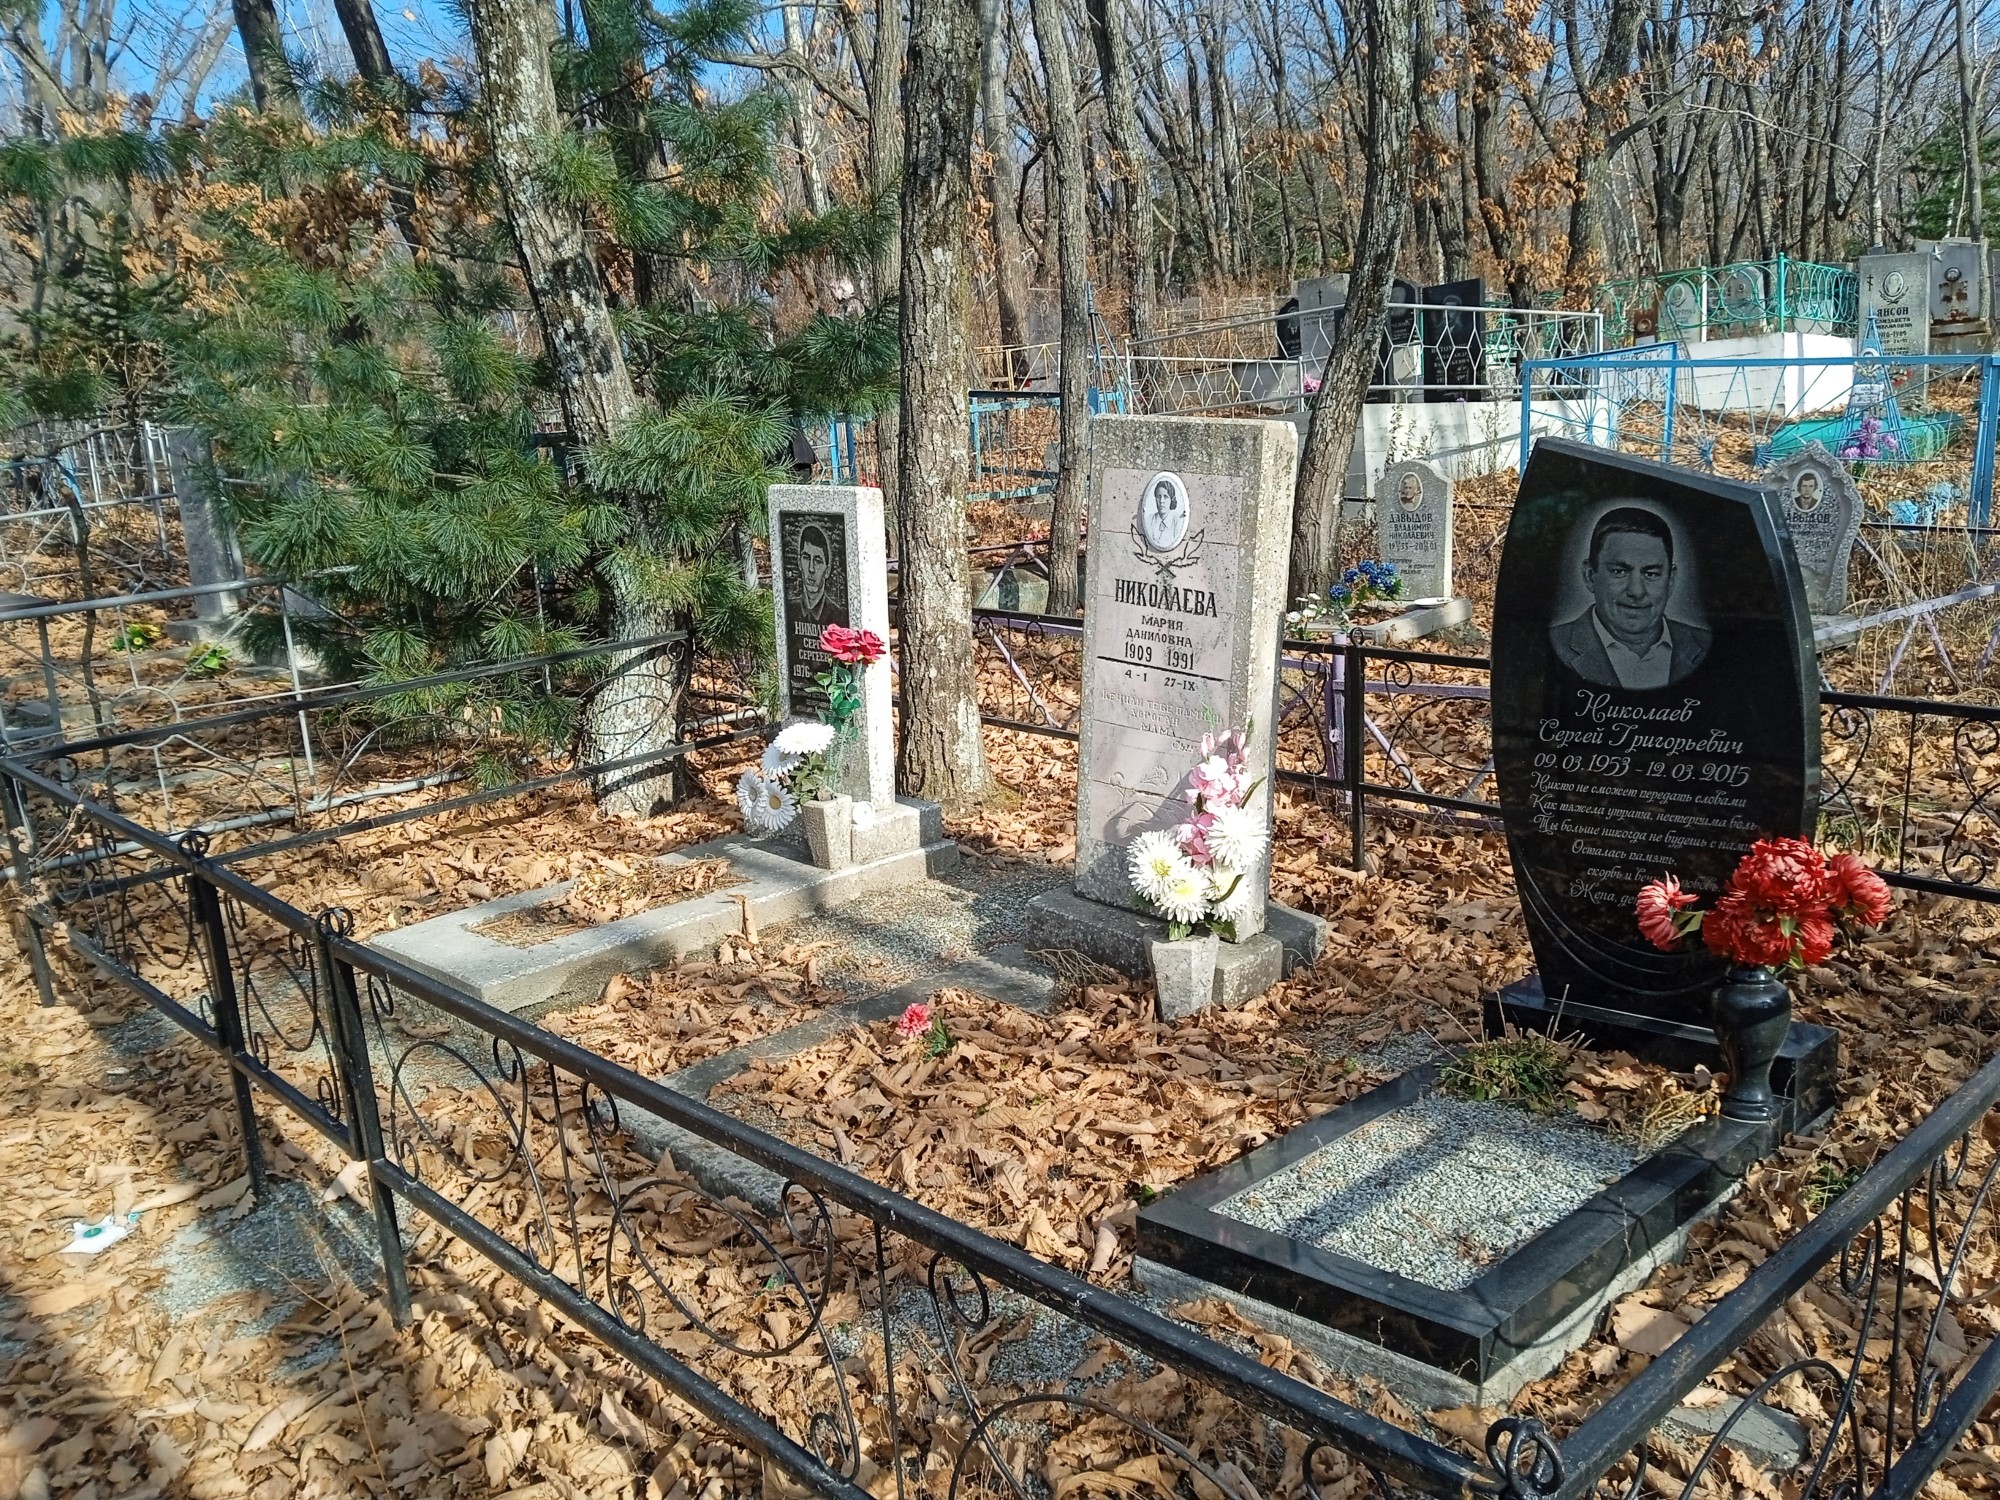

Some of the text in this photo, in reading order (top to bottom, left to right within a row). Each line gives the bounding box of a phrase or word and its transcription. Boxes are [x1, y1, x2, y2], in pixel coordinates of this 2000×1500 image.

[1877, 307, 1909, 317] ЯНСОН
[1389, 513, 1433, 523] ДАВЫДОВ
[1114, 578, 1218, 618] НИКОЛАЕВА
[1126, 628, 1193, 648] ДАНИЛОВНА
[1141, 615, 1184, 631] МАРИЯ
[1124, 641, 1195, 671] 1909 1991
[1575, 689, 1701, 723] Николаев
[1539, 719, 1744, 757] Сергей Григорьевич
[1531, 771, 1747, 808] Никто не сможет передать словами
[1530, 793, 1558, 815] Как
[1559, 802, 1605, 816] тяжела
[1656, 812, 1727, 828] нестерпима
[1533, 814, 1558, 835] Ты
[1560, 819, 1600, 836] больше
[1601, 828, 1647, 844] никогда
[1649, 833, 1663, 843] не
[1664, 830, 1707, 849] будешь
[1709, 840, 1716, 849] с
[1571, 839, 1627, 860] Осталась
[1587, 865, 1624, 881] скорбь
[1625, 871, 1633, 881] и
